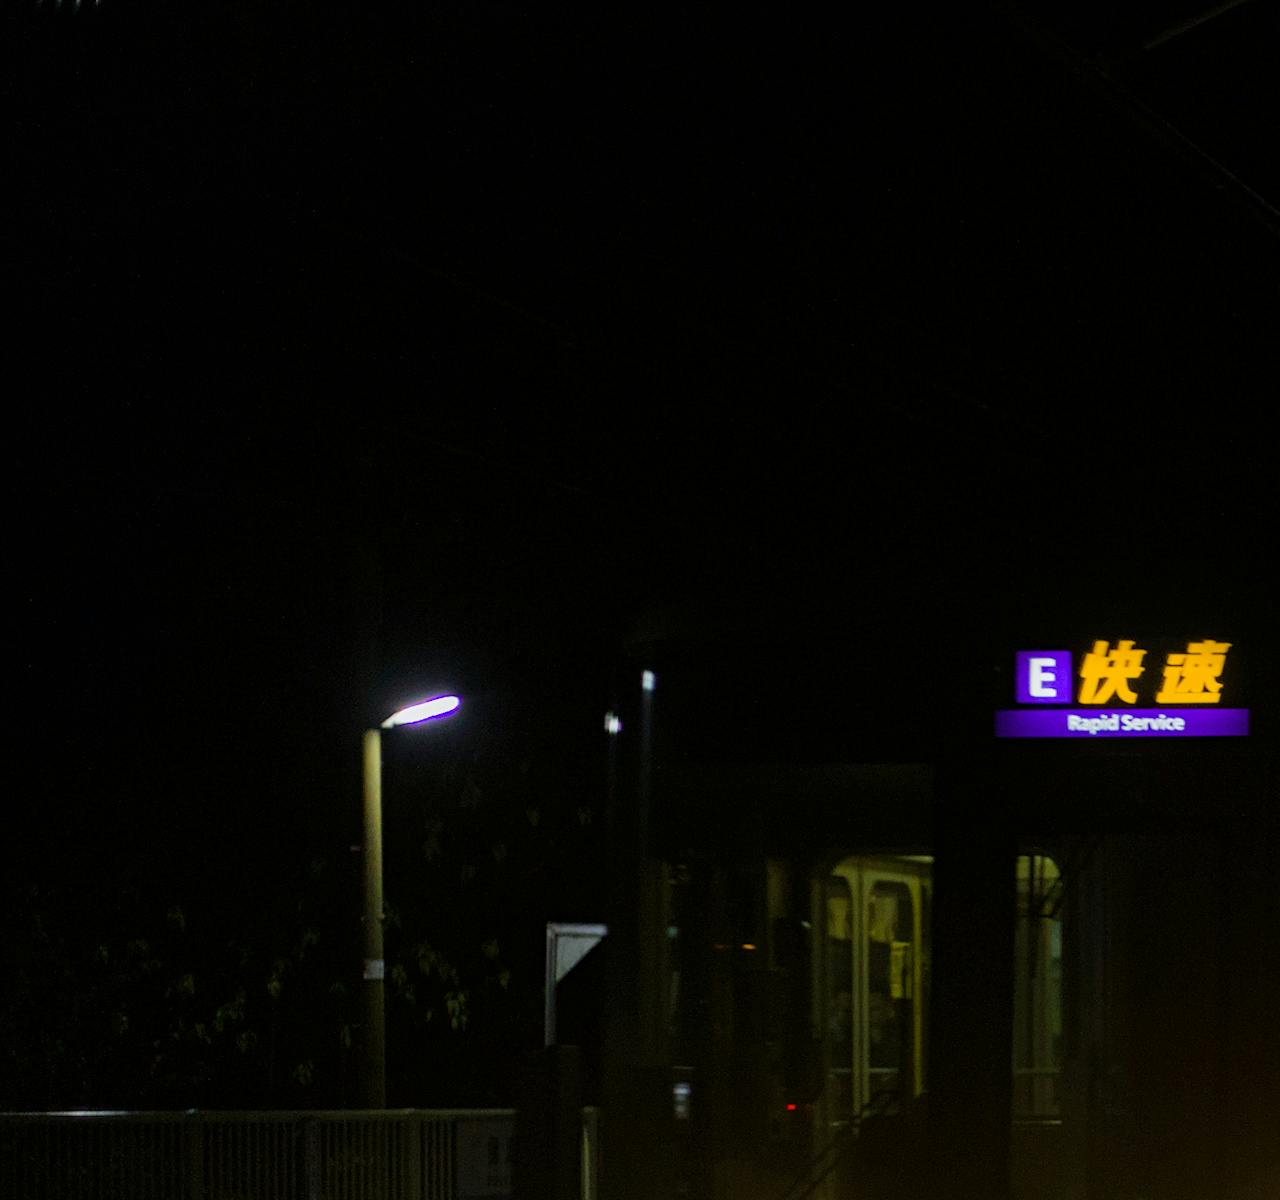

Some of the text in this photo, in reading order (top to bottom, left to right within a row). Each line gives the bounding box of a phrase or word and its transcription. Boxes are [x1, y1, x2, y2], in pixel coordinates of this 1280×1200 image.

[1028, 657, 1058, 698] E
[1078, 639, 1233, 704] 快速
[1066, 713, 1186, 735] Rapid Service
